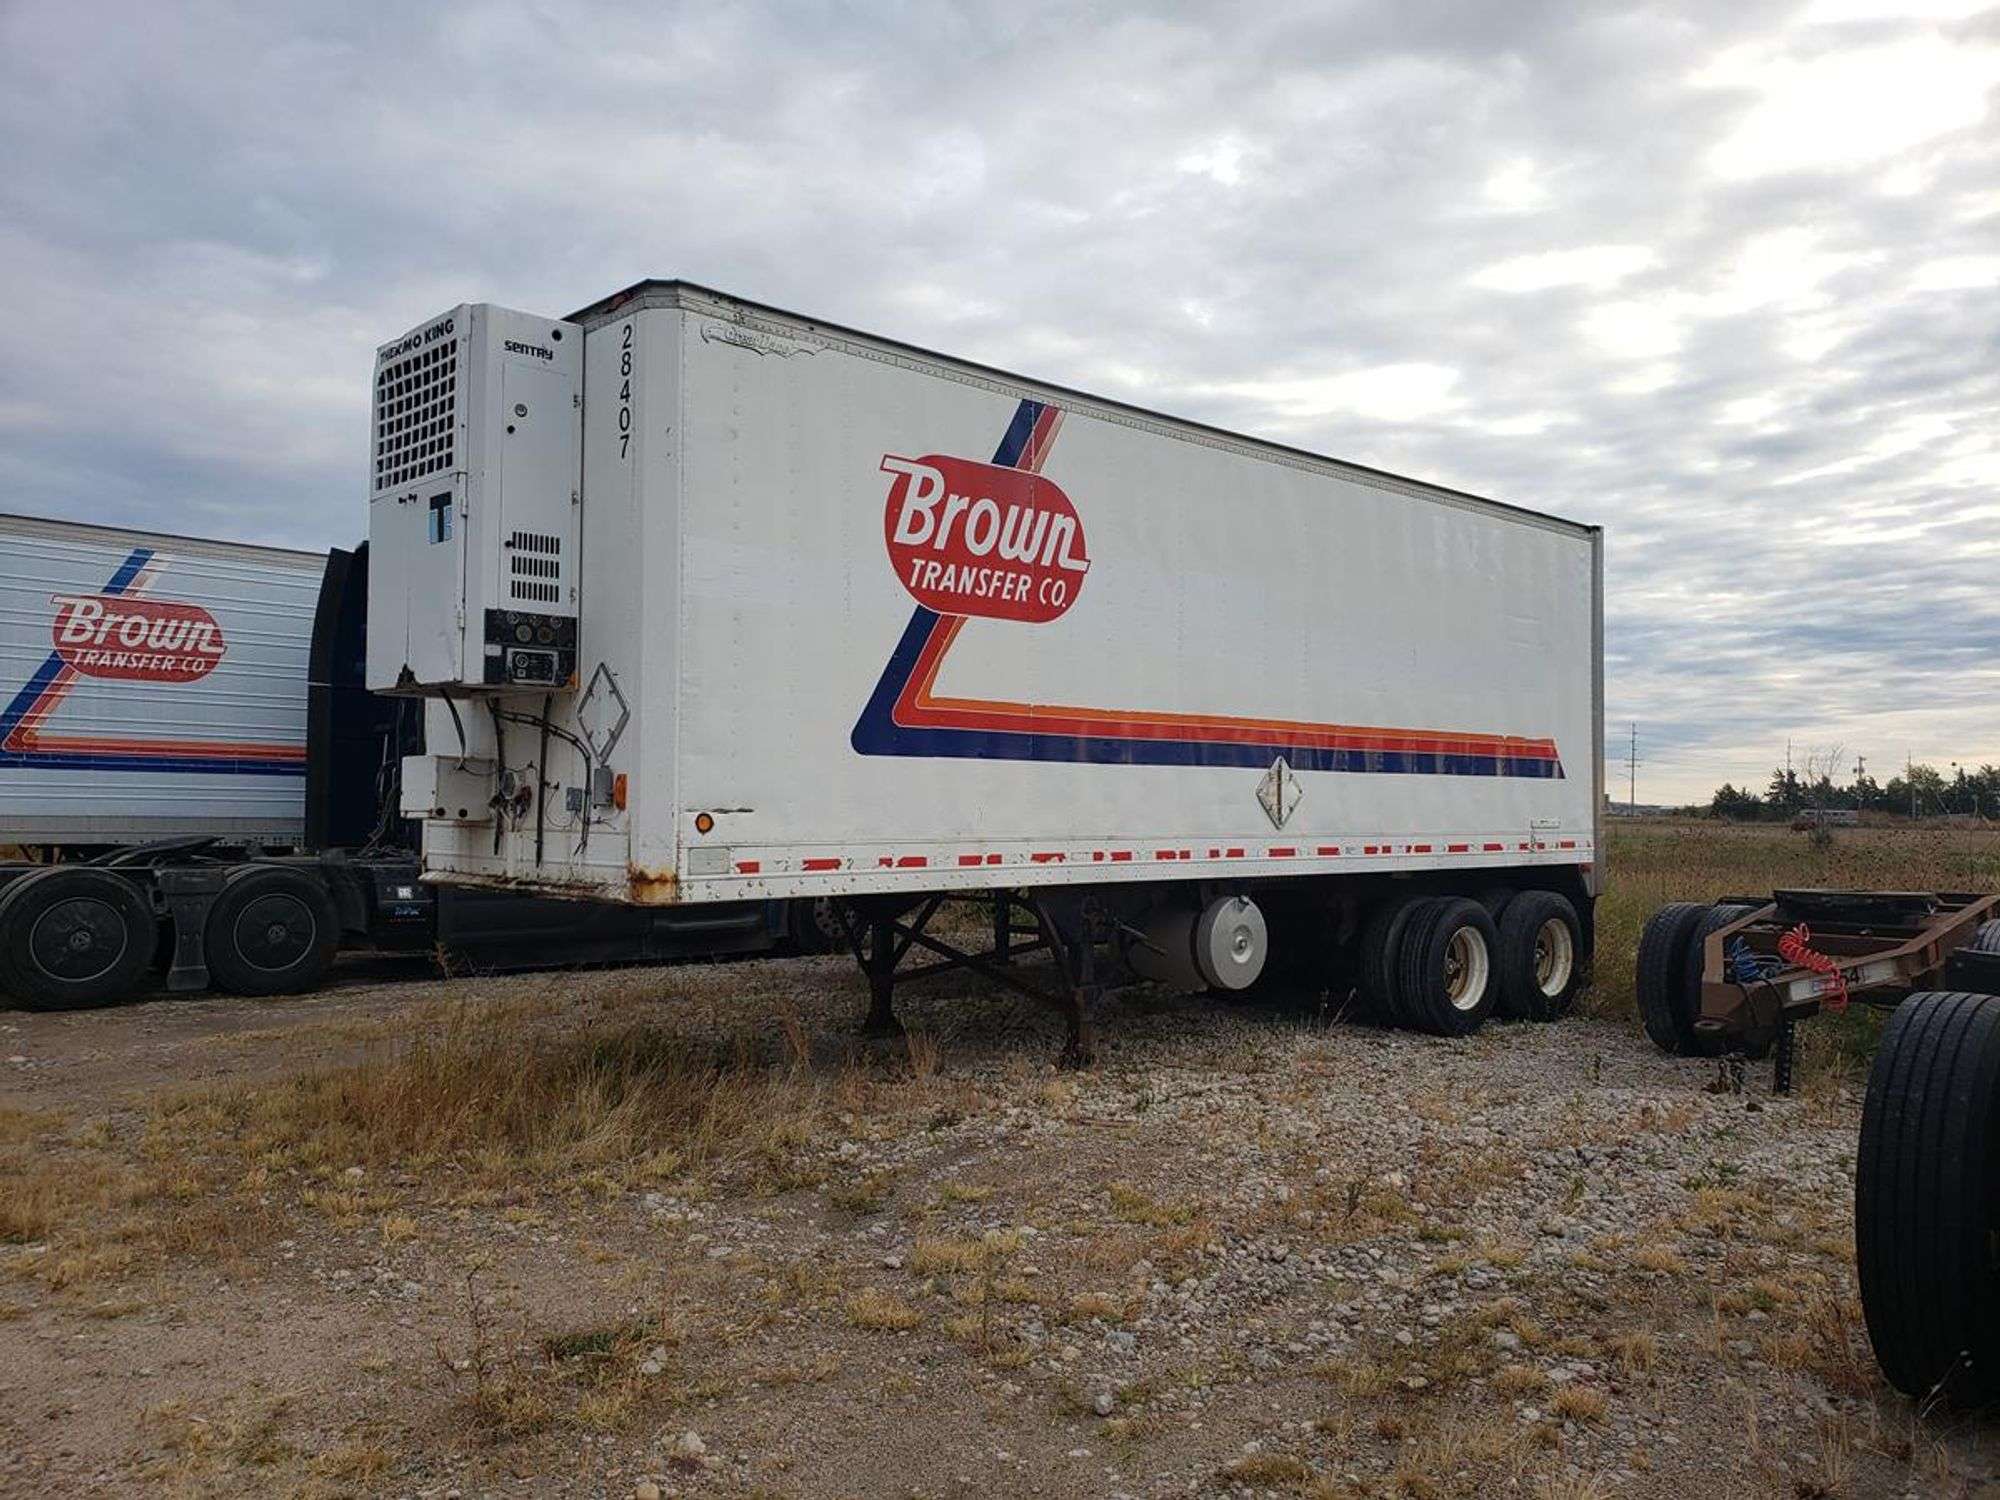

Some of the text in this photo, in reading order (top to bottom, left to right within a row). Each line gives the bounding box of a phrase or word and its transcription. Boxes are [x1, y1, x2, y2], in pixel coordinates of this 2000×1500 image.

[424, 319, 454, 344] KING
[618, 325, 633, 459] 28407
[880, 455, 1091, 574] Brown
[909, 558, 1067, 608] TRANSFER CO.
[52, 595, 227, 654] Brown
[73, 650, 177, 672] TRANSFER
